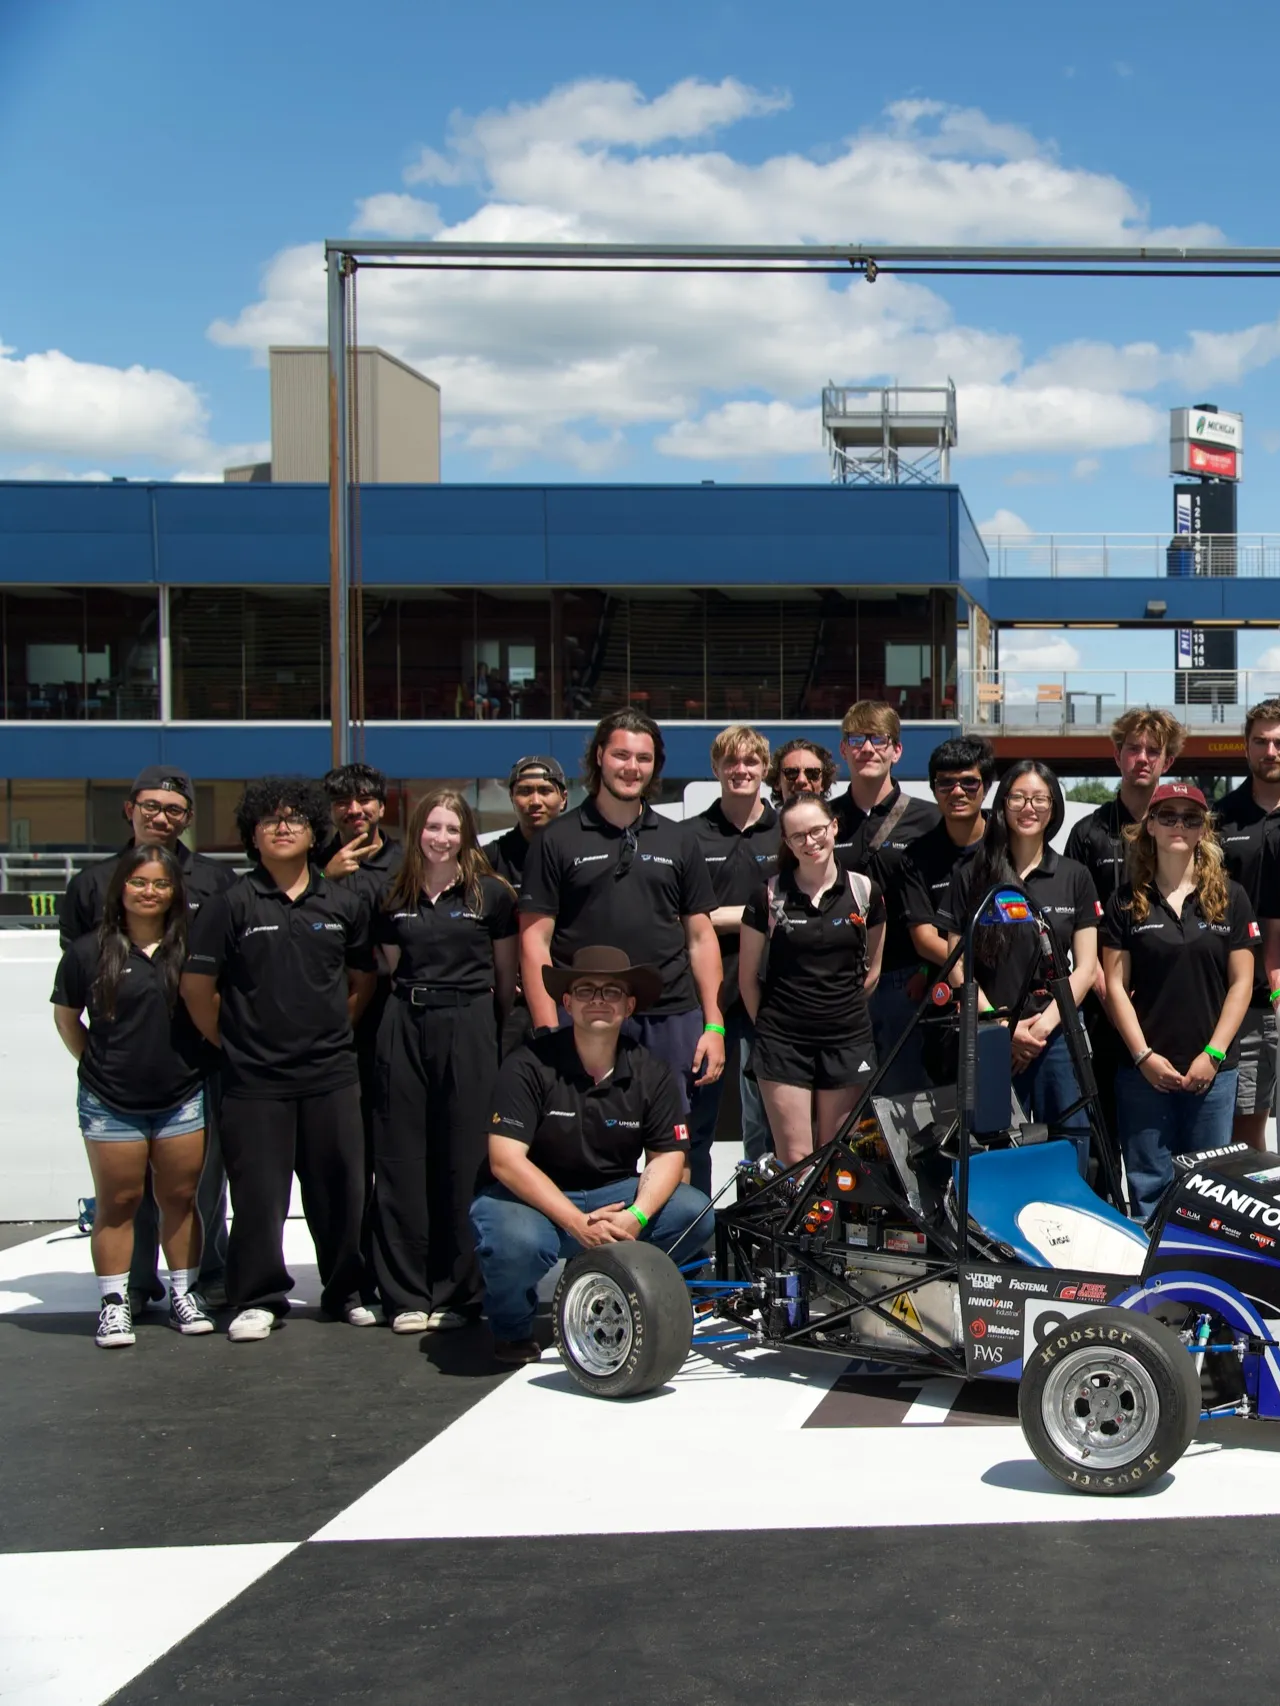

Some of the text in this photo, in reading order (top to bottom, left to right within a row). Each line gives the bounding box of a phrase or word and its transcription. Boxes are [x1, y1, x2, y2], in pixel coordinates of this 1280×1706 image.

[1193, 633, 1205, 644] 13
[1193, 645, 1205, 655] 14
[1193, 656, 1205, 667] 15
[1208, 743, 1245, 751] CLEARAN
[1196, 1142, 1249, 1161] BOEING
[1249, 1232, 1276, 1248] CARTE
[965, 1272, 1003, 1284] CUTTING
[972, 1280, 995, 1290] EDGE
[1008, 1278, 1048, 1293] FASTENAL
[967, 1296, 1014, 1310] INNOVAIR
[987, 1324, 1020, 1336] Wabtec
[1040, 1327, 1132, 1364] Hoosier
